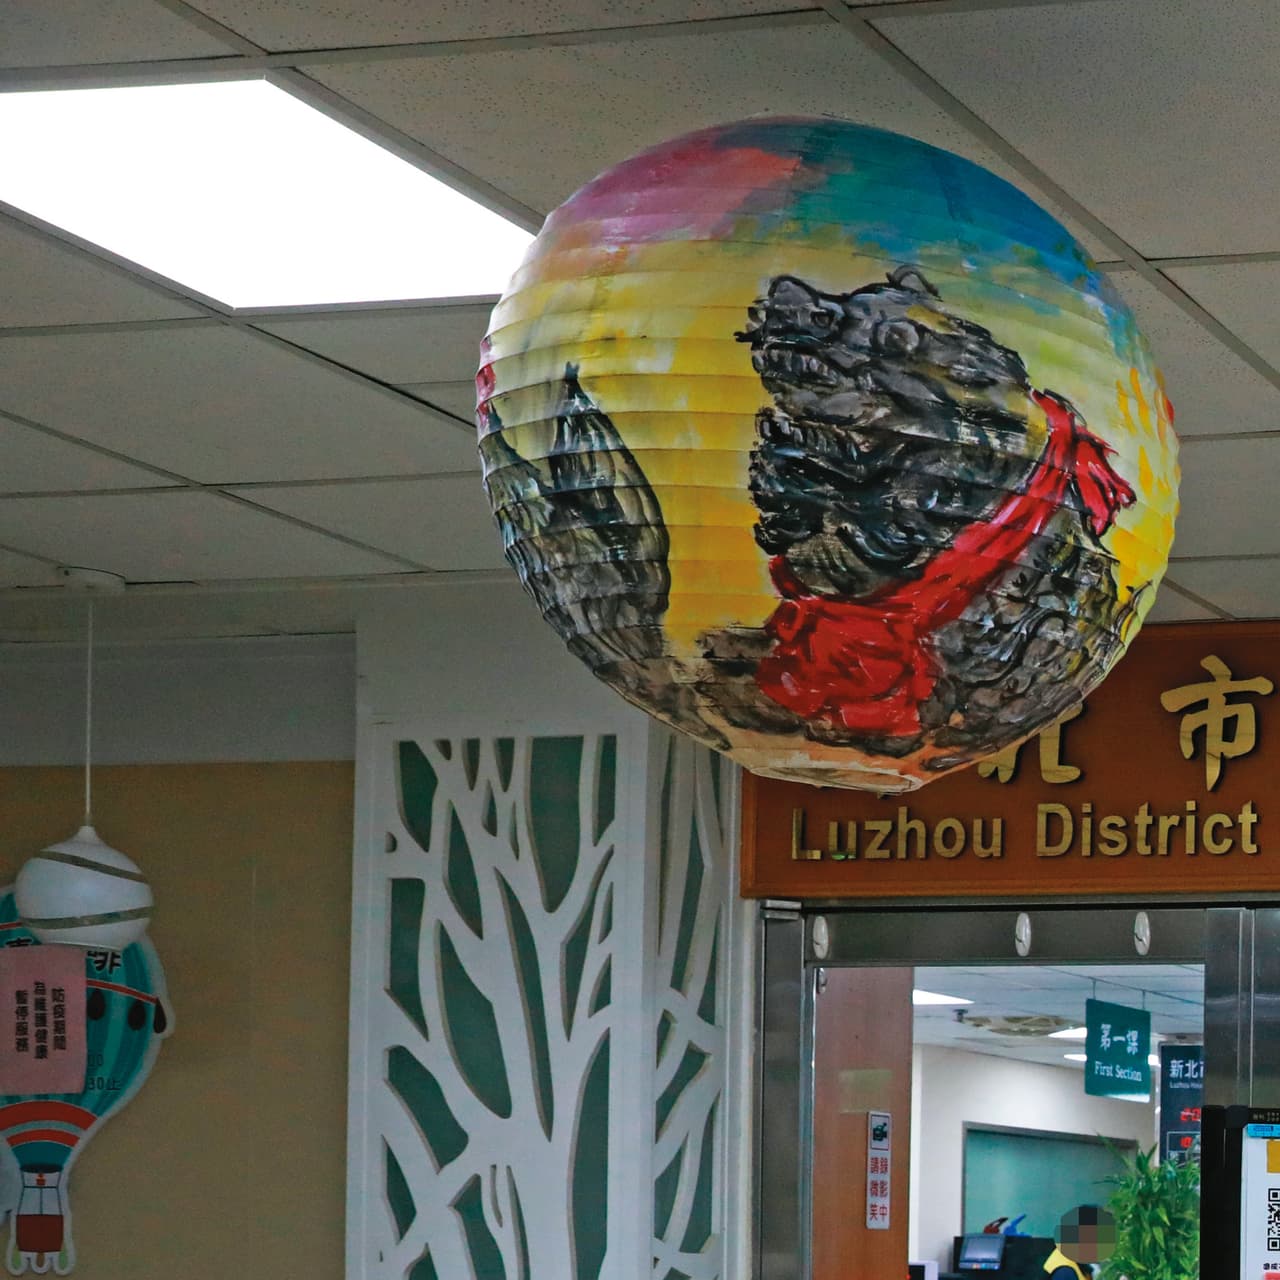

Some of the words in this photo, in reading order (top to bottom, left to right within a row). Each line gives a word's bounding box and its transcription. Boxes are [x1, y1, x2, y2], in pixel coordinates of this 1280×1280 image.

[792, 807, 1003, 860] Luzhou
[1035, 799, 1260, 857] District
[1100, 1024, 1139, 1055] 第一課
[1094, 1061, 1113, 1077] First
[1115, 1065, 1142, 1081] Section
